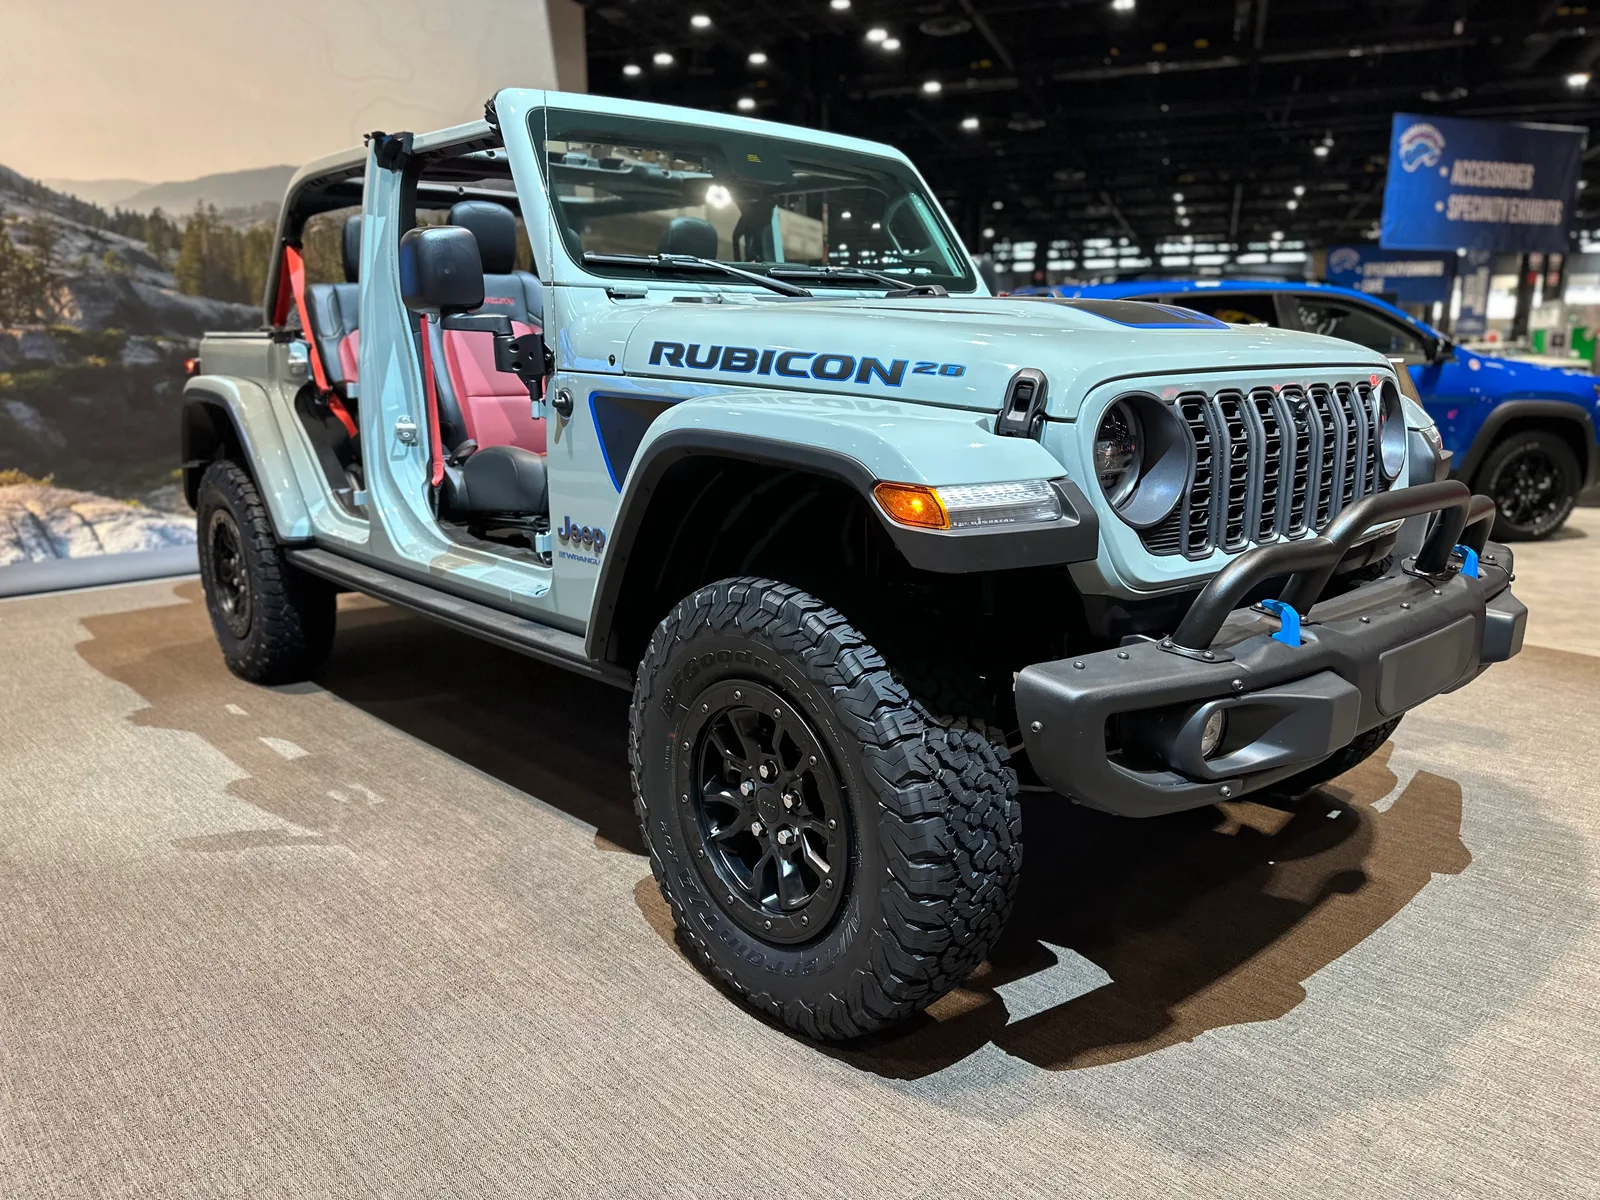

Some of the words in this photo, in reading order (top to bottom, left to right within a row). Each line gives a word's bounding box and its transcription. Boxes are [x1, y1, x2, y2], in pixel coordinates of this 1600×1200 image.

[1450, 159, 1535, 190] ACCESSORIES
[648, 341, 909, 387] RUBICON
[911, 361, 967, 378] 20
[557, 515, 607, 553] Jeep
